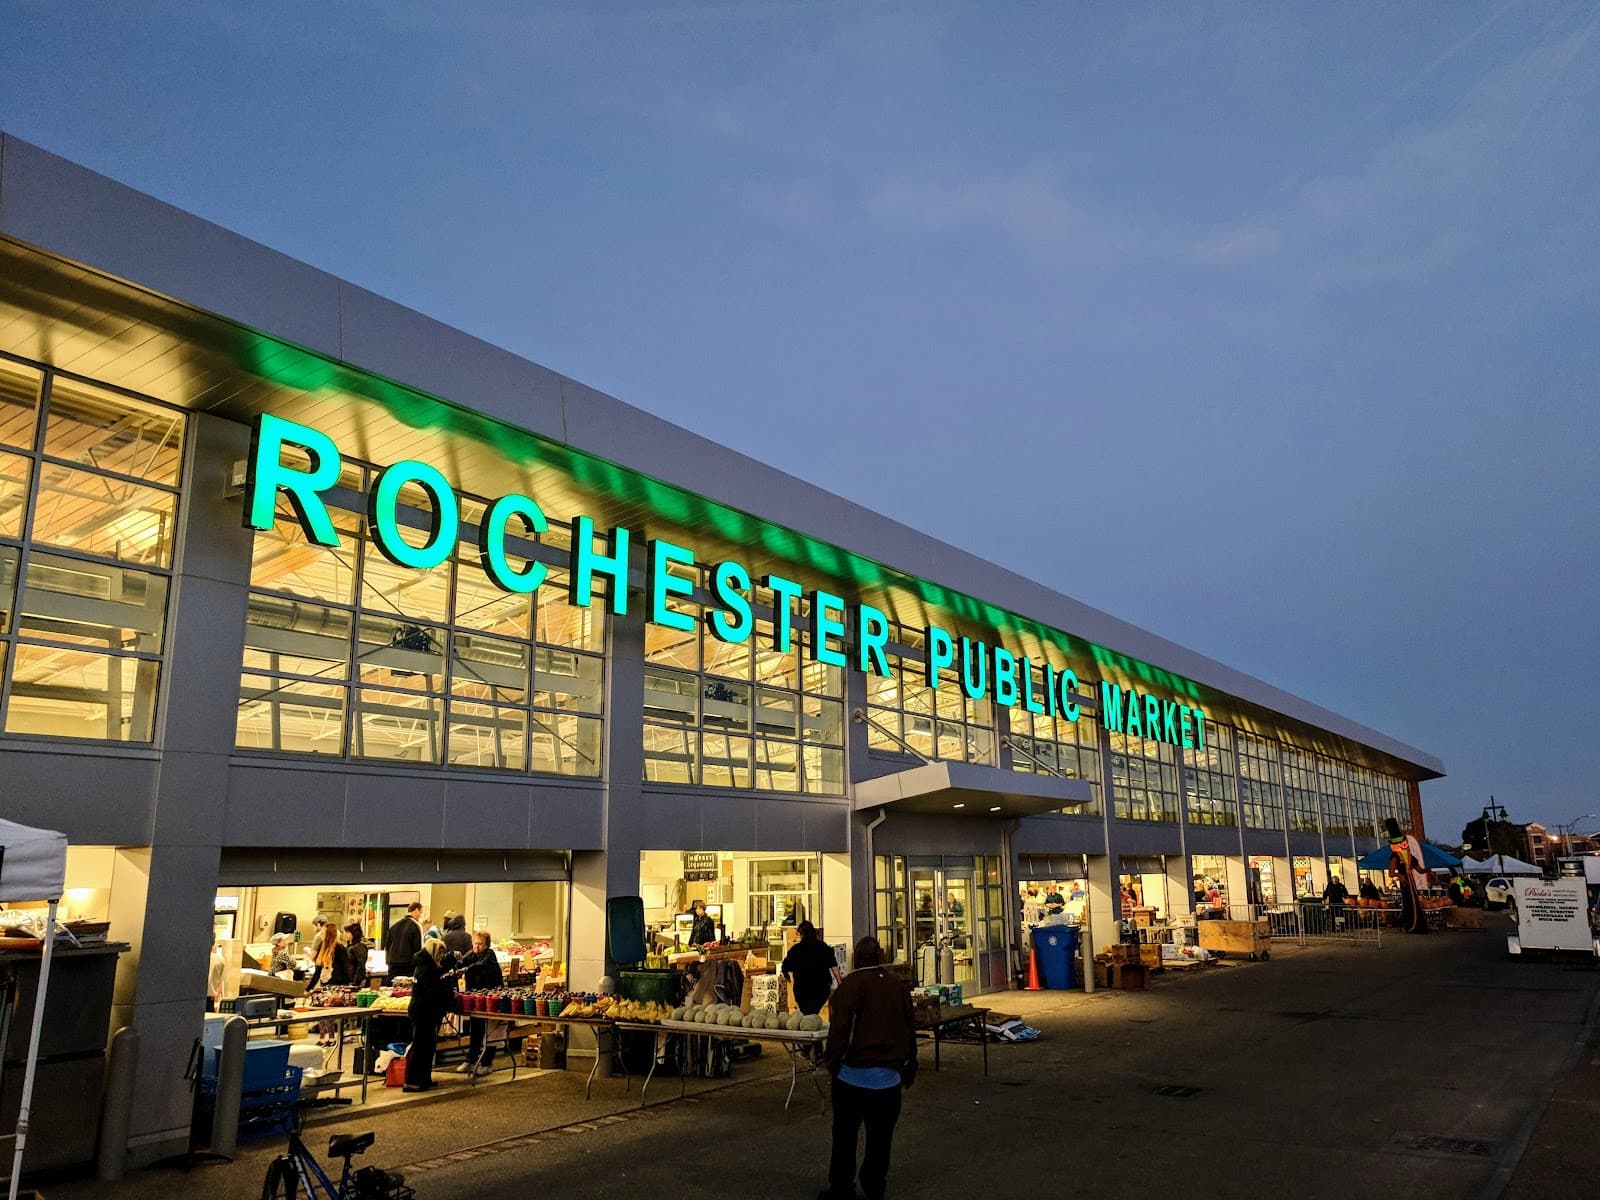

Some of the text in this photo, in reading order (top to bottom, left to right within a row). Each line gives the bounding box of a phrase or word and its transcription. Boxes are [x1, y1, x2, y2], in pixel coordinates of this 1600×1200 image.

[246, 412, 1206, 751] ROCHESTER PUBLIC MARKET
